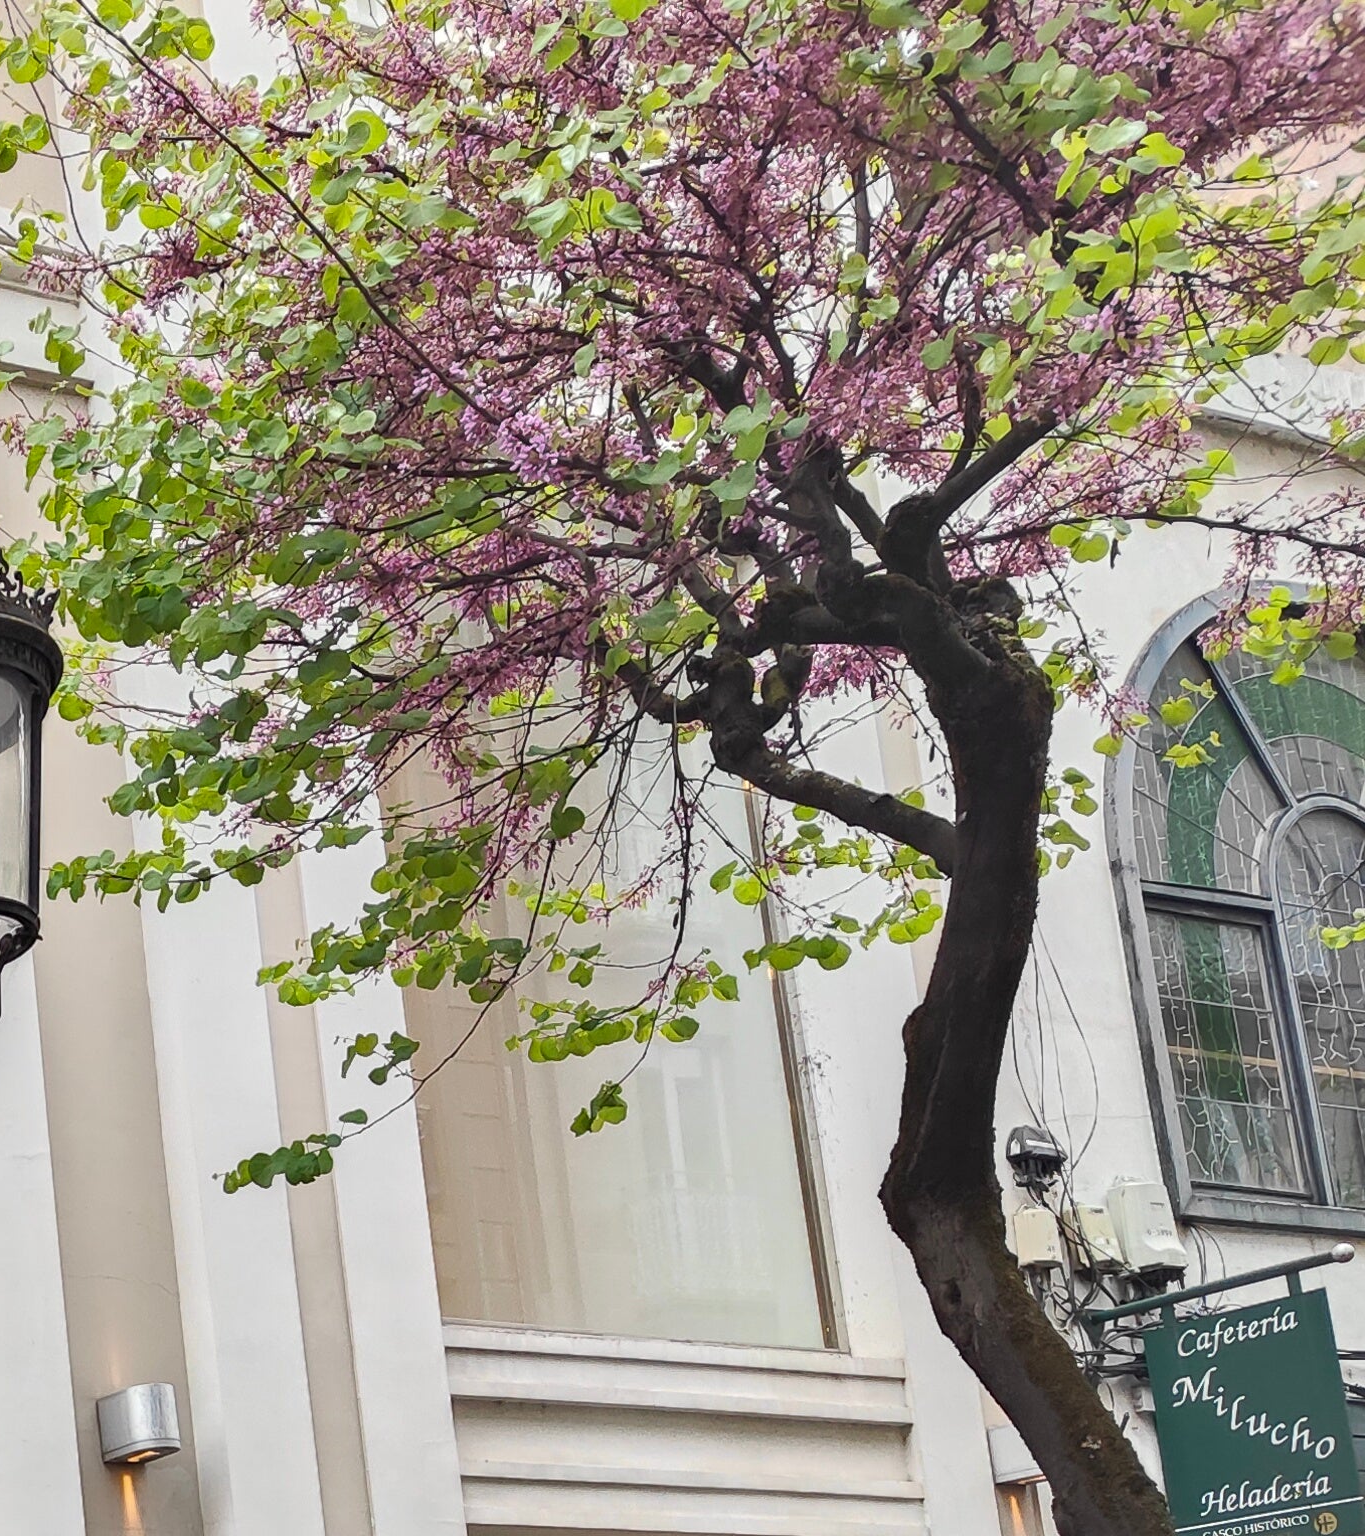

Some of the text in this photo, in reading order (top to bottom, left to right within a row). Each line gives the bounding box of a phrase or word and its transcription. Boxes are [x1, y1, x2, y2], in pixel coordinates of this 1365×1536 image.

[1178, 1305, 1299, 1358] Cafetería
[1172, 1366, 1336, 1460] Milucho
[1200, 1472, 1333, 1517] Heladería
[1244, 1513, 1310, 1535] HISTÓRICO
